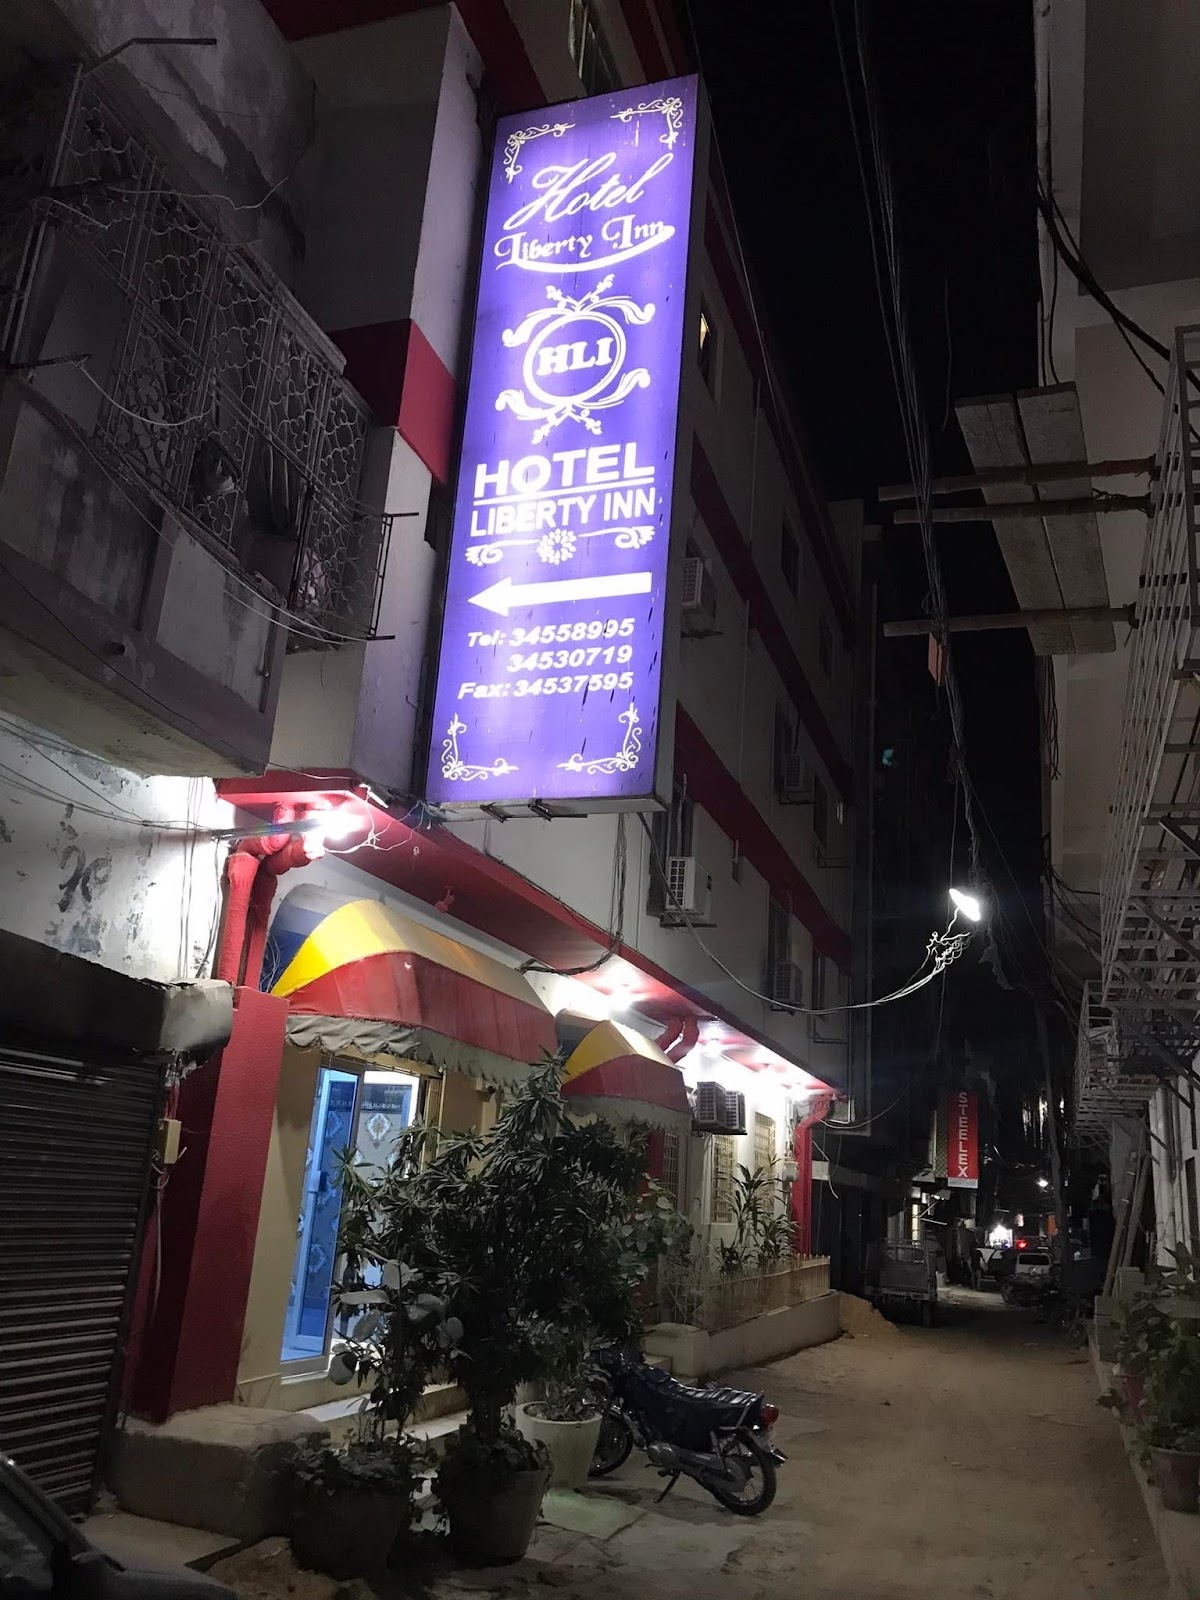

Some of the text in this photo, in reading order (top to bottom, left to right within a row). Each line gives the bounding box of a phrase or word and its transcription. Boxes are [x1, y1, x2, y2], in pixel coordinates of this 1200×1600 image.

[503, 152, 674, 231] Hotel
[494, 214, 664, 264] Liberty Inn
[536, 337, 613, 376] HLI
[474, 442, 655, 498] HOTEL
[470, 487, 656, 537] LIBERTY INN
[467, 617, 636, 648] Tel: 34558995
[507, 644, 633, 673] 34530719
[458, 671, 635, 699] Fax: 34537595
[958, 1092, 969, 1178] STEELEX
